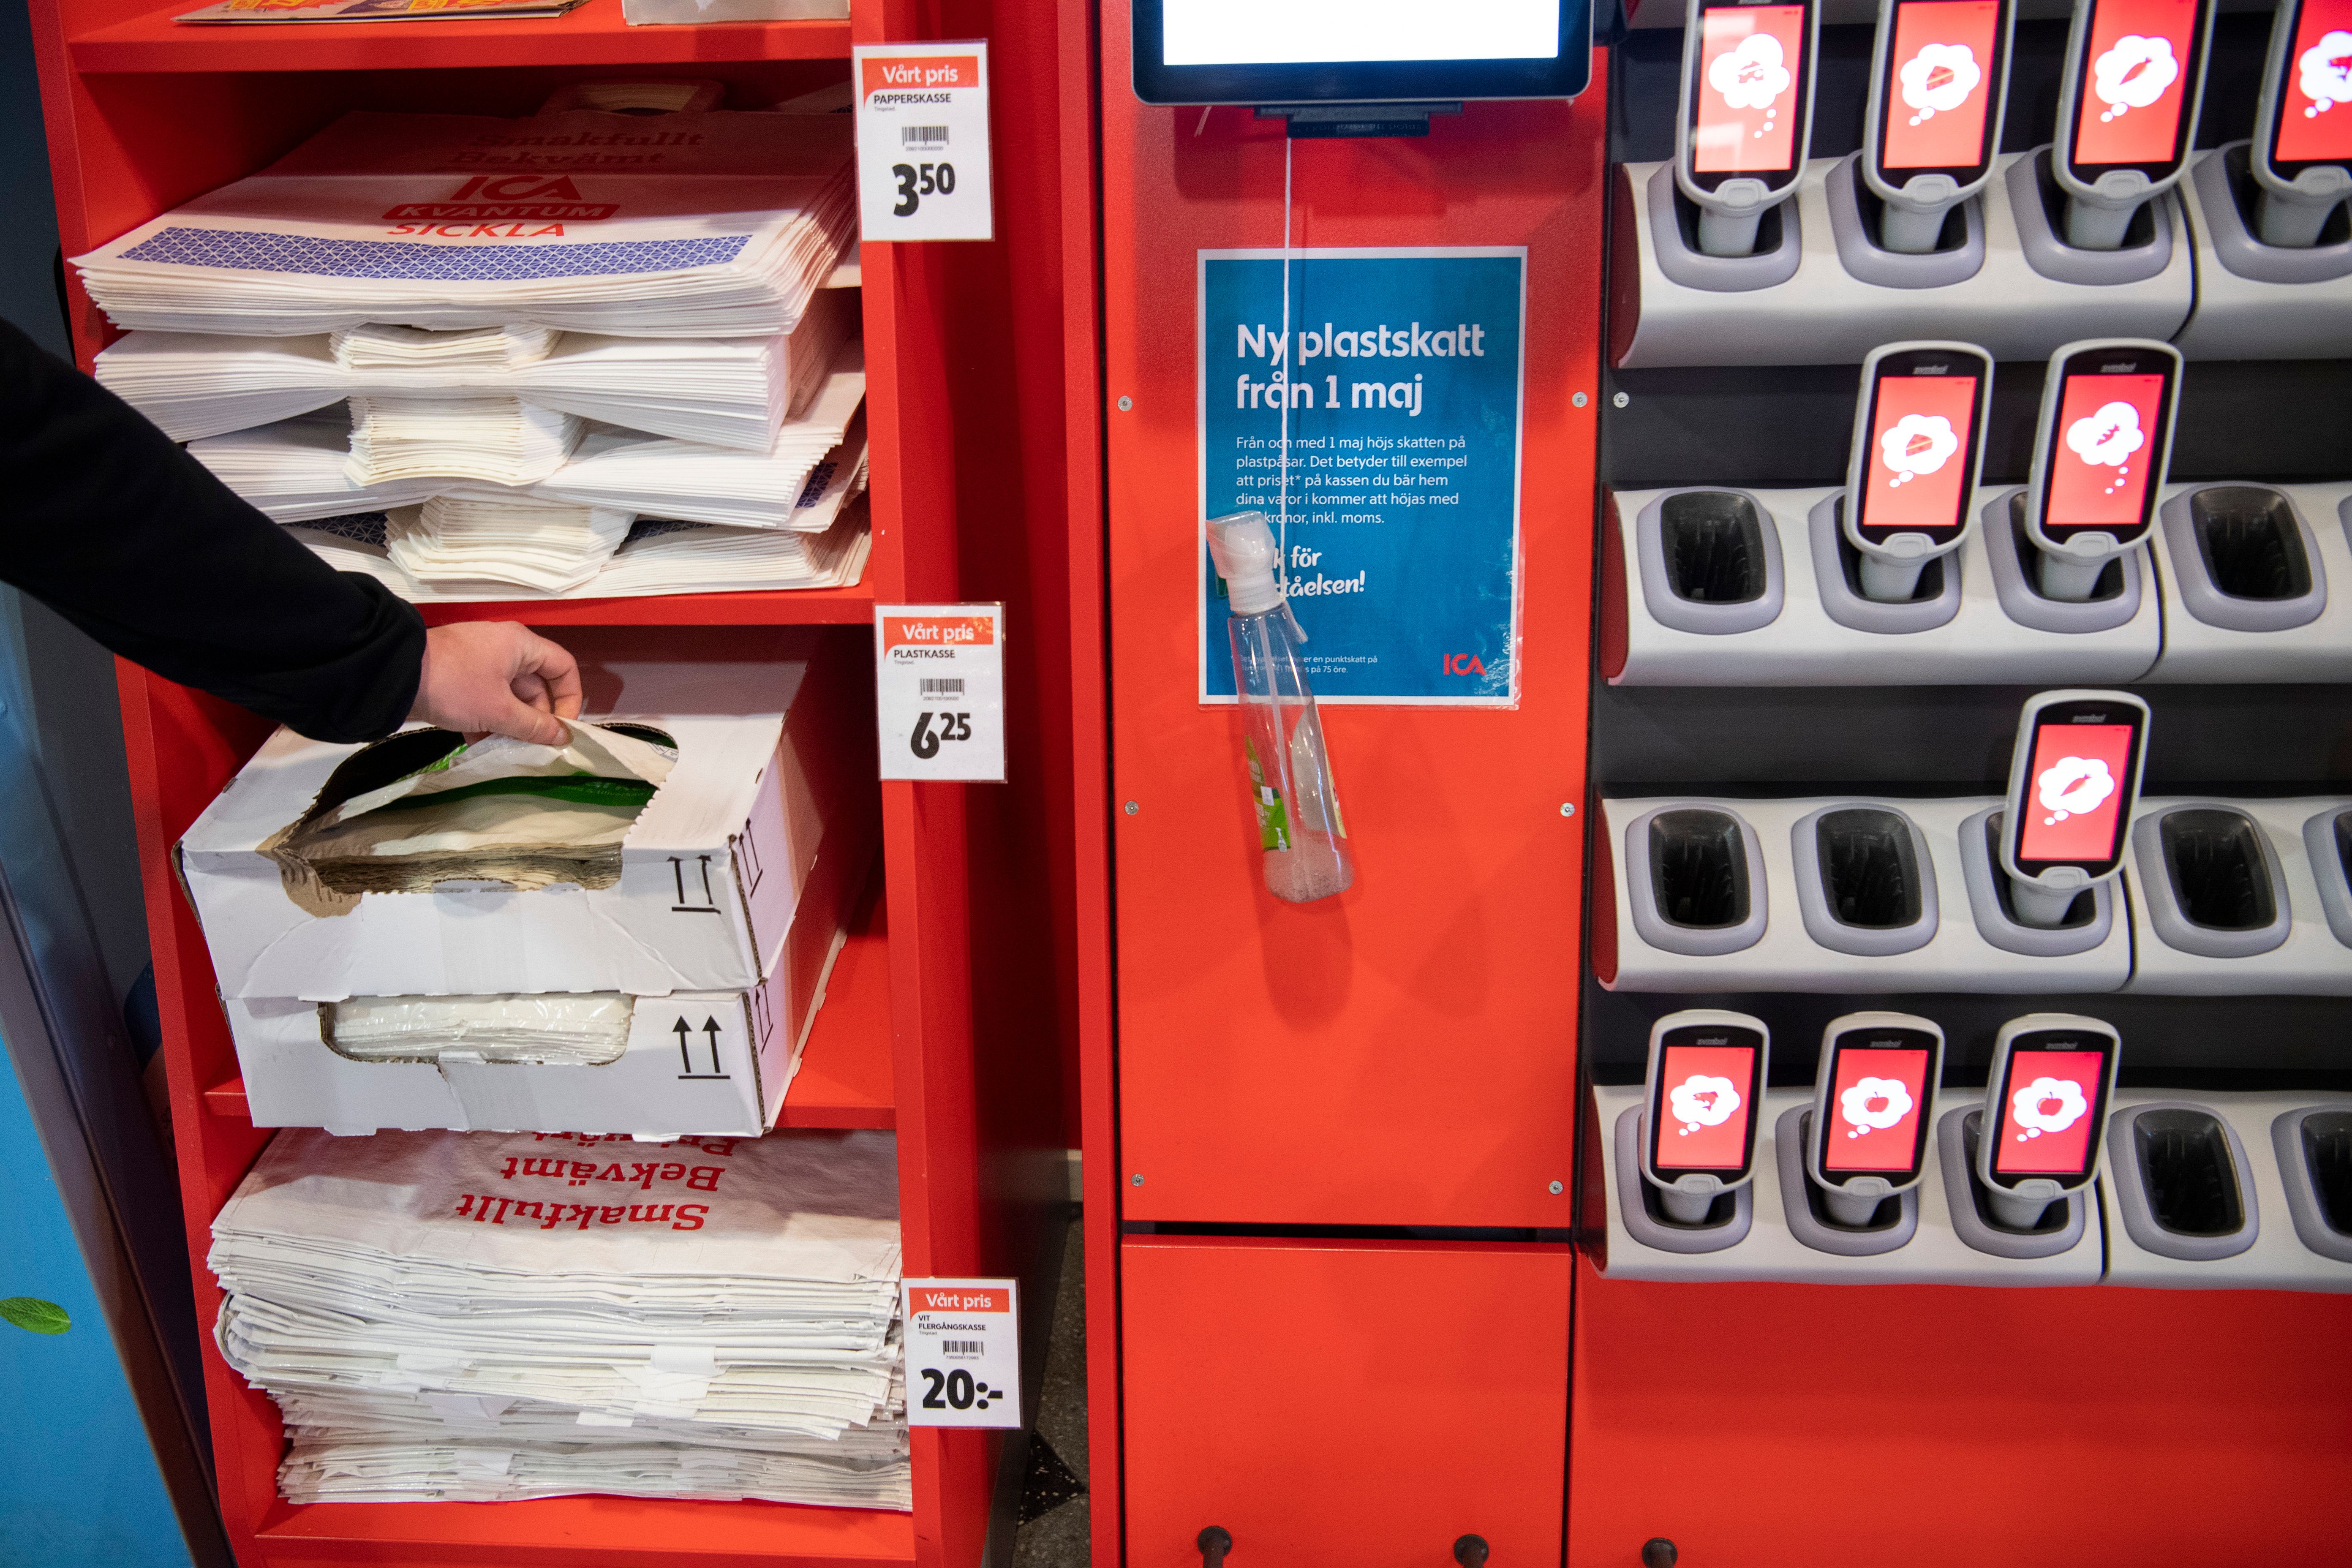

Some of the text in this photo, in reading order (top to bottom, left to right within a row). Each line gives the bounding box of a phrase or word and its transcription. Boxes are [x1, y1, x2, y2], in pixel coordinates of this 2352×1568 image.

[882, 64, 958, 86] Vårt pris
[874, 93, 951, 104] PAPPERSKASSE
[469, 132, 706, 147] Smakfullt
[450, 175, 583, 201] ICA
[397, 206, 607, 218] KVANTUM
[387, 223, 565, 237] SICKLA
[1238, 322, 1485, 366] Ny plastskatt
[1237, 371, 1423, 416] från 1 maj
[1236, 436, 1264, 448] Från
[1296, 436, 1325, 448] med
[1330, 437, 1335, 448] 1
[1339, 436, 1363, 451] maj
[1367, 436, 1394, 451] höjs
[1397, 436, 1445, 448] skatten
[1449, 435, 1466, 450] på
[1236, 455, 1467, 470] plastpåsar. Det betyder till exempel
[1236, 476, 1254, 486] att
[1305, 474, 1321, 488] på
[1326, 474, 1369, 486] kassen
[1373, 474, 1390, 485] du
[1394, 474, 1416, 485] bär
[1419, 474, 1448, 485] hem
[1236, 493, 1264, 504] dina
[1305, 493, 1308, 504] i
[1312, 493, 1367, 504] kommer
[1369, 494, 1387, 504] att
[1391, 493, 1425, 507] höjas
[1429, 493, 1459, 504] med
[1312, 512, 1337, 523] inkl.
[1341, 514, 1384, 523] moms.
[1290, 545, 1322, 568] för
[903, 623, 974, 643] Vårt pris
[894, 650, 955, 658] PLASTKASSE
[1325, 656, 1366, 664] punktskatt
[1367, 655, 1378, 664] på
[1311, 665, 1321, 674] på
[1444, 653, 1486, 675] ICA
[501, 1157, 726, 1192] Bekvämt
[456, 1194, 709, 1231] Smakfullt
[926, 1292, 991, 1310] Vårt pris
[918, 1322, 986, 1331] FLERGÅNGSKASSE
[921, 1368, 1003, 1410] 20:-
